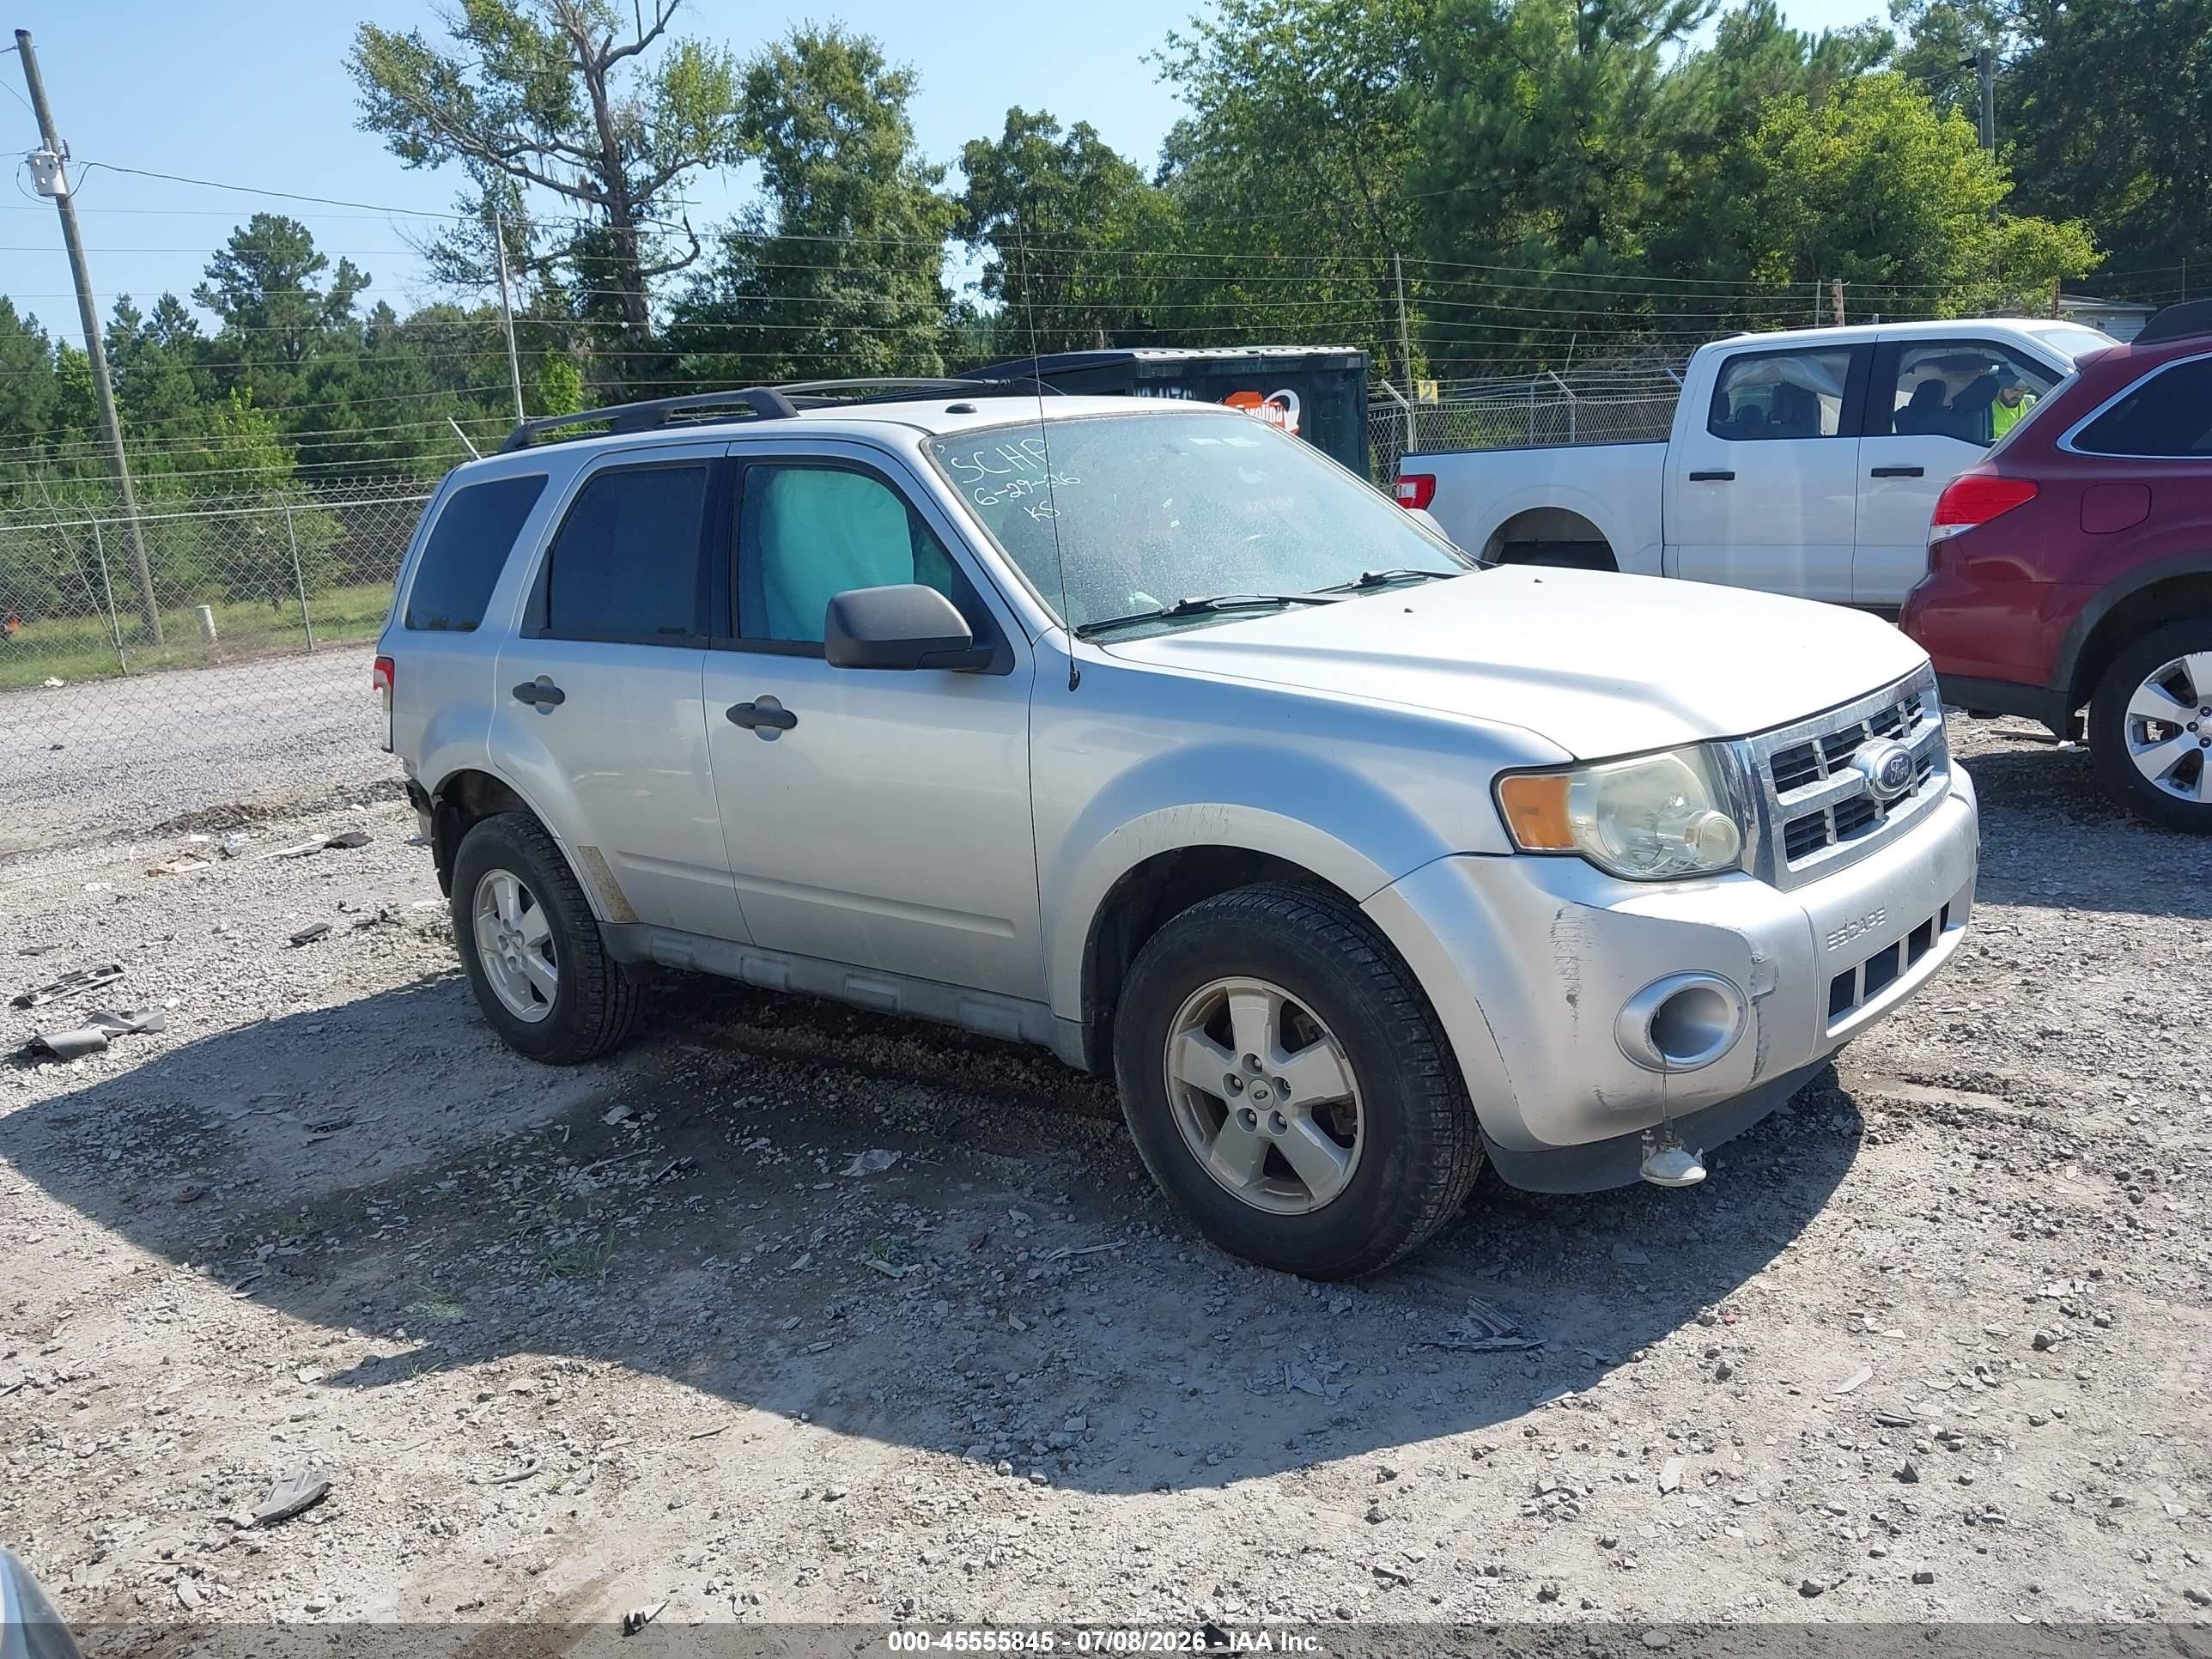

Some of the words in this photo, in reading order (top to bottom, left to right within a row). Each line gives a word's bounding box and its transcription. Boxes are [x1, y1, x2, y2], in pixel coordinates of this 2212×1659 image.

[1420, 381, 1434, 404] 2
[951, 439, 1052, 483] SCHP
[974, 471, 1081, 505] 6-29-26
[1023, 501, 1060, 522] KS
[1890, 756, 1910, 782] Ford
[1826, 906, 1887, 951] ESCAPE
